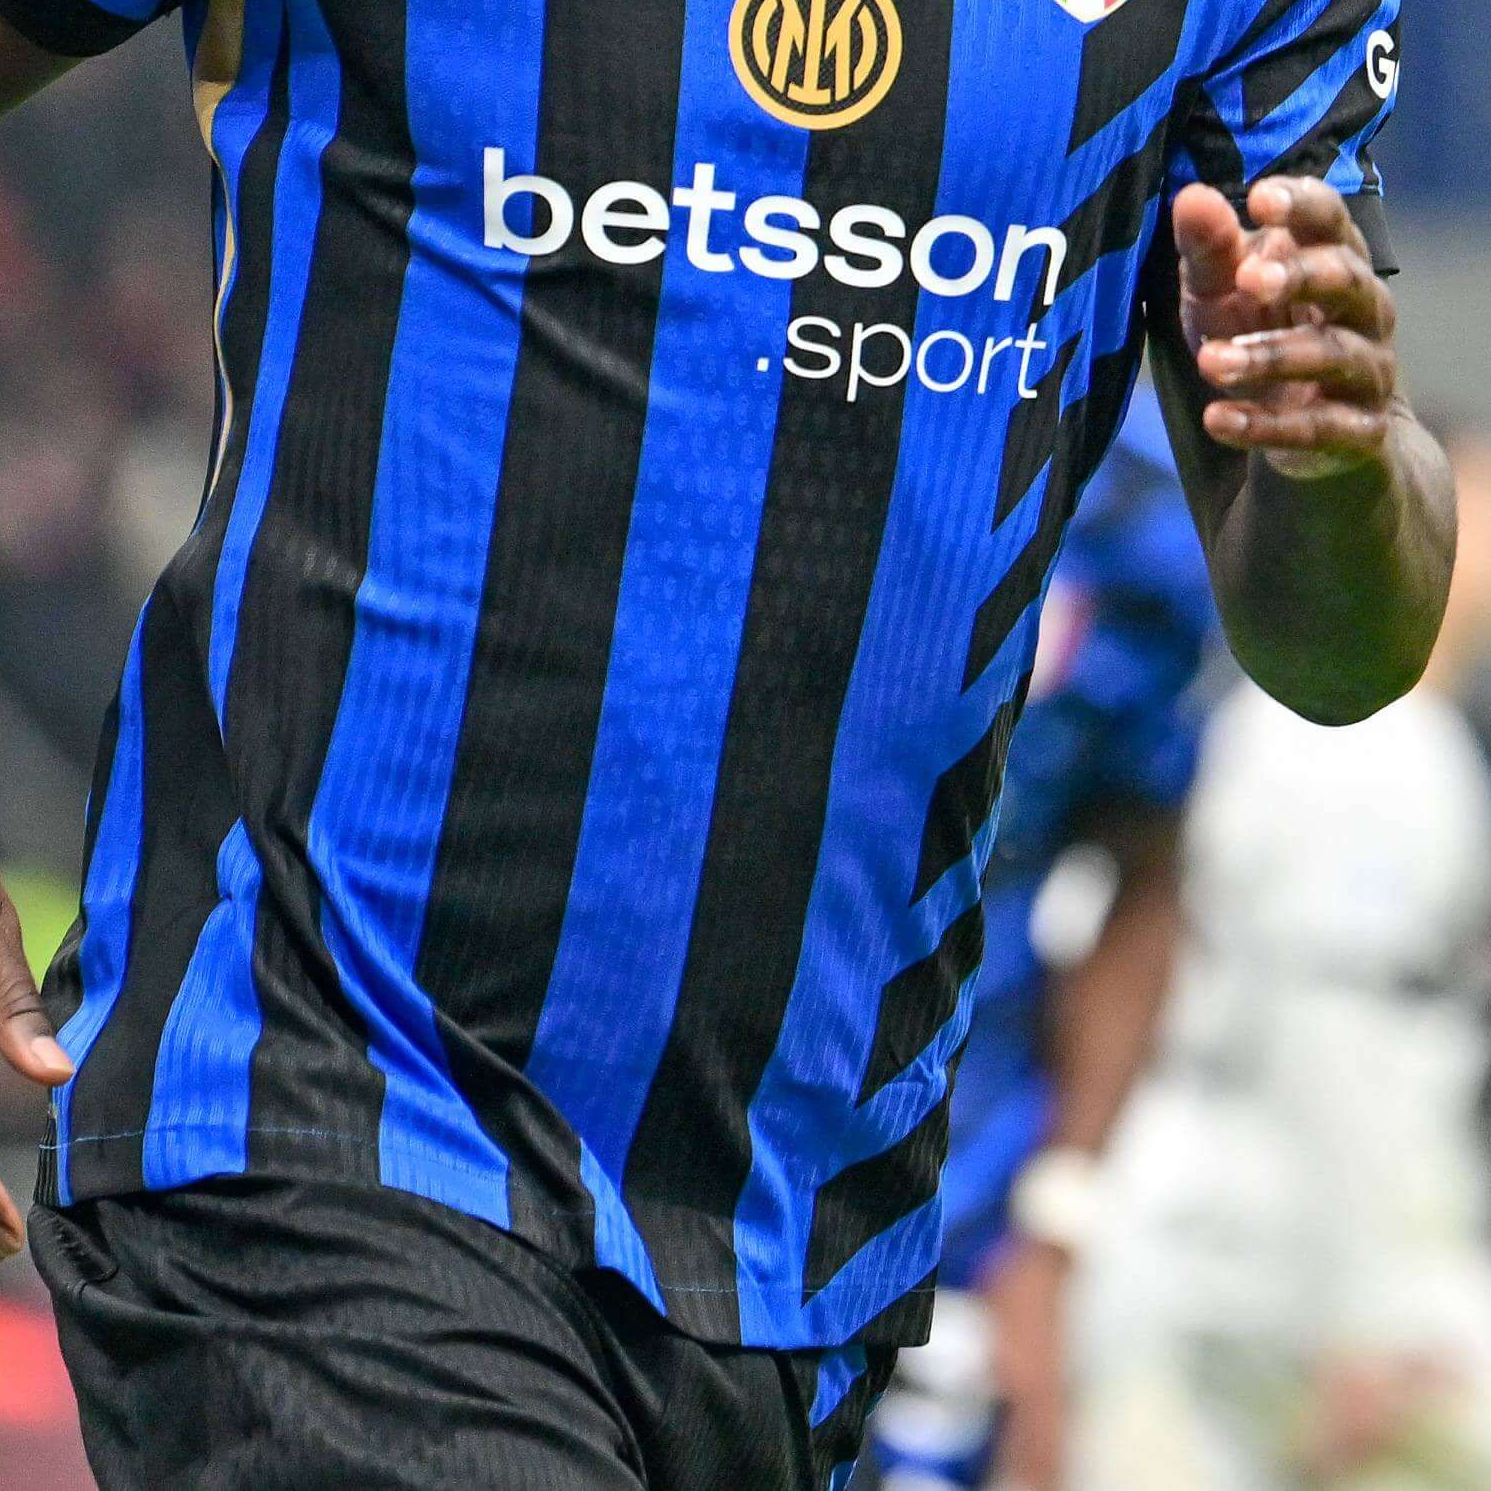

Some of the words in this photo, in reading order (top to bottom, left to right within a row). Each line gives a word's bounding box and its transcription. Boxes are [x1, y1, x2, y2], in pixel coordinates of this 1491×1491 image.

[1366, 29, 1400, 99] G
[483, 147, 1067, 306] betsson
[757, 316, 1047, 401] .sport
